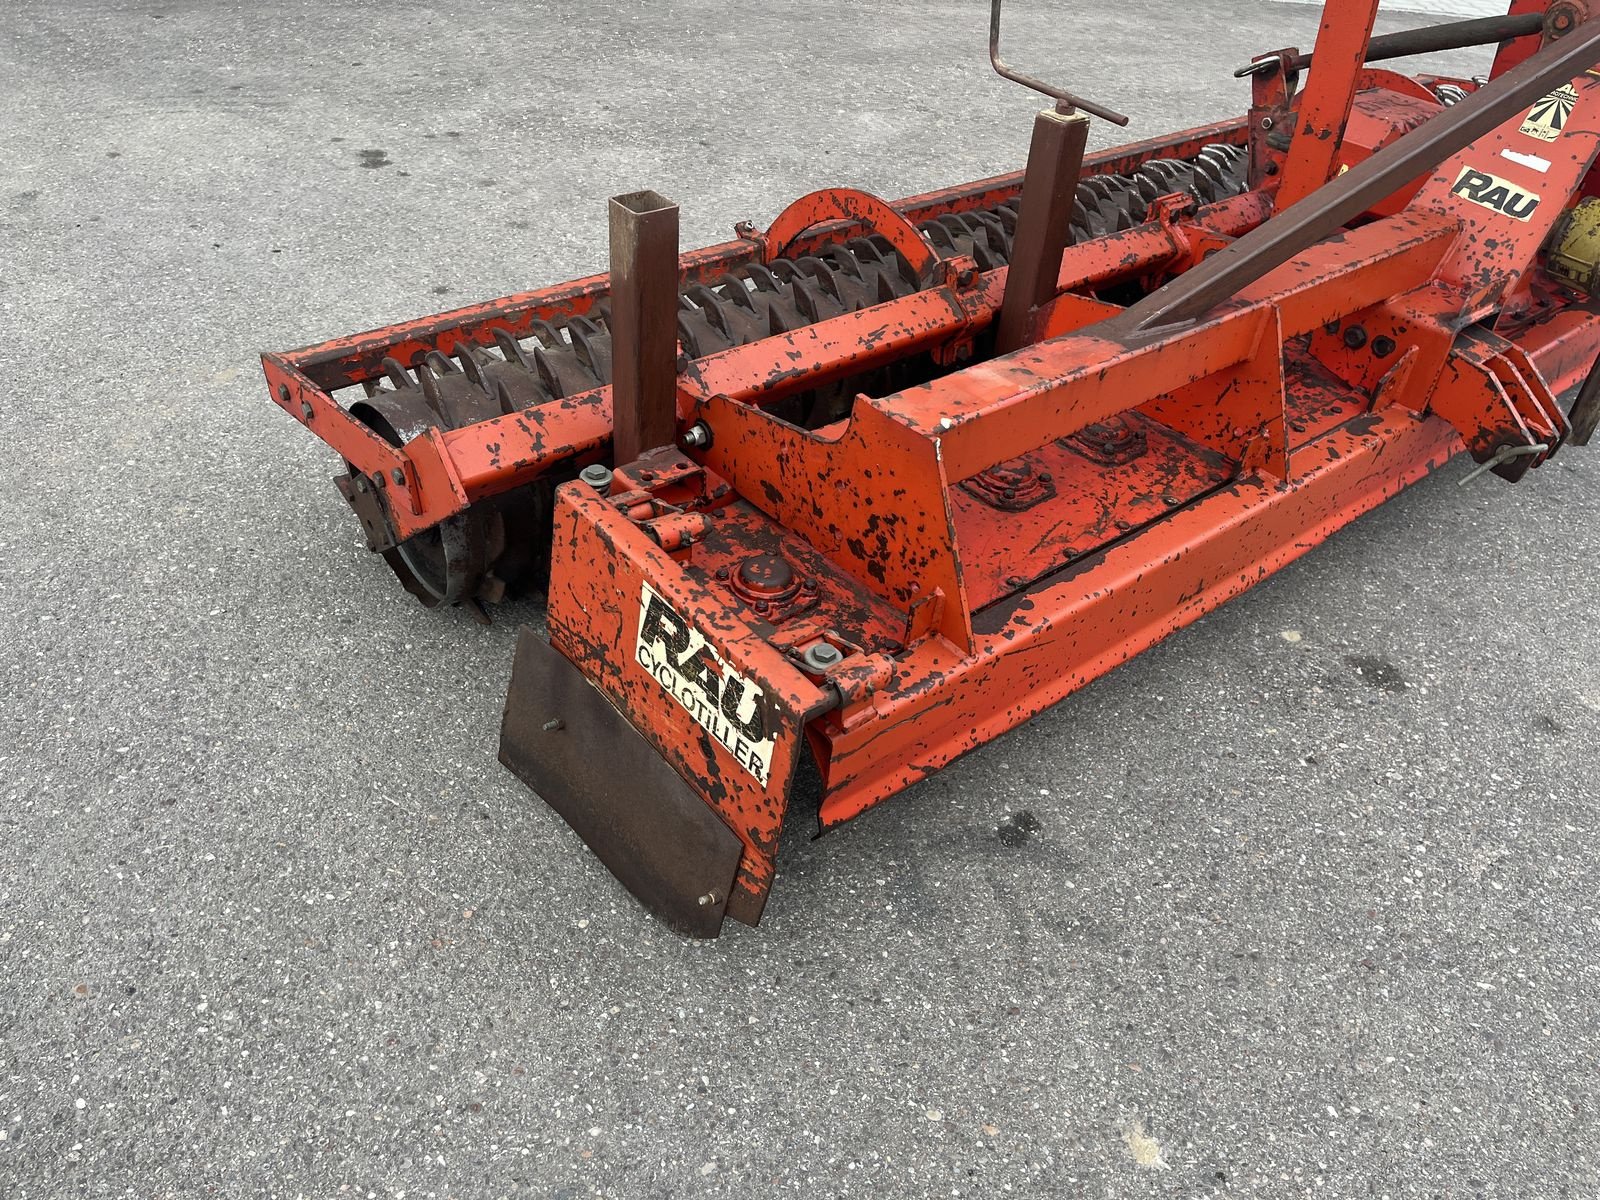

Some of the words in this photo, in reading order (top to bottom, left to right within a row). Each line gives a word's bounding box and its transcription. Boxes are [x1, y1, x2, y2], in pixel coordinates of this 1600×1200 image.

[1556, 83, 1579, 97] AU
[1451, 169, 1539, 218] RAU
[640, 593, 764, 743] RAU
